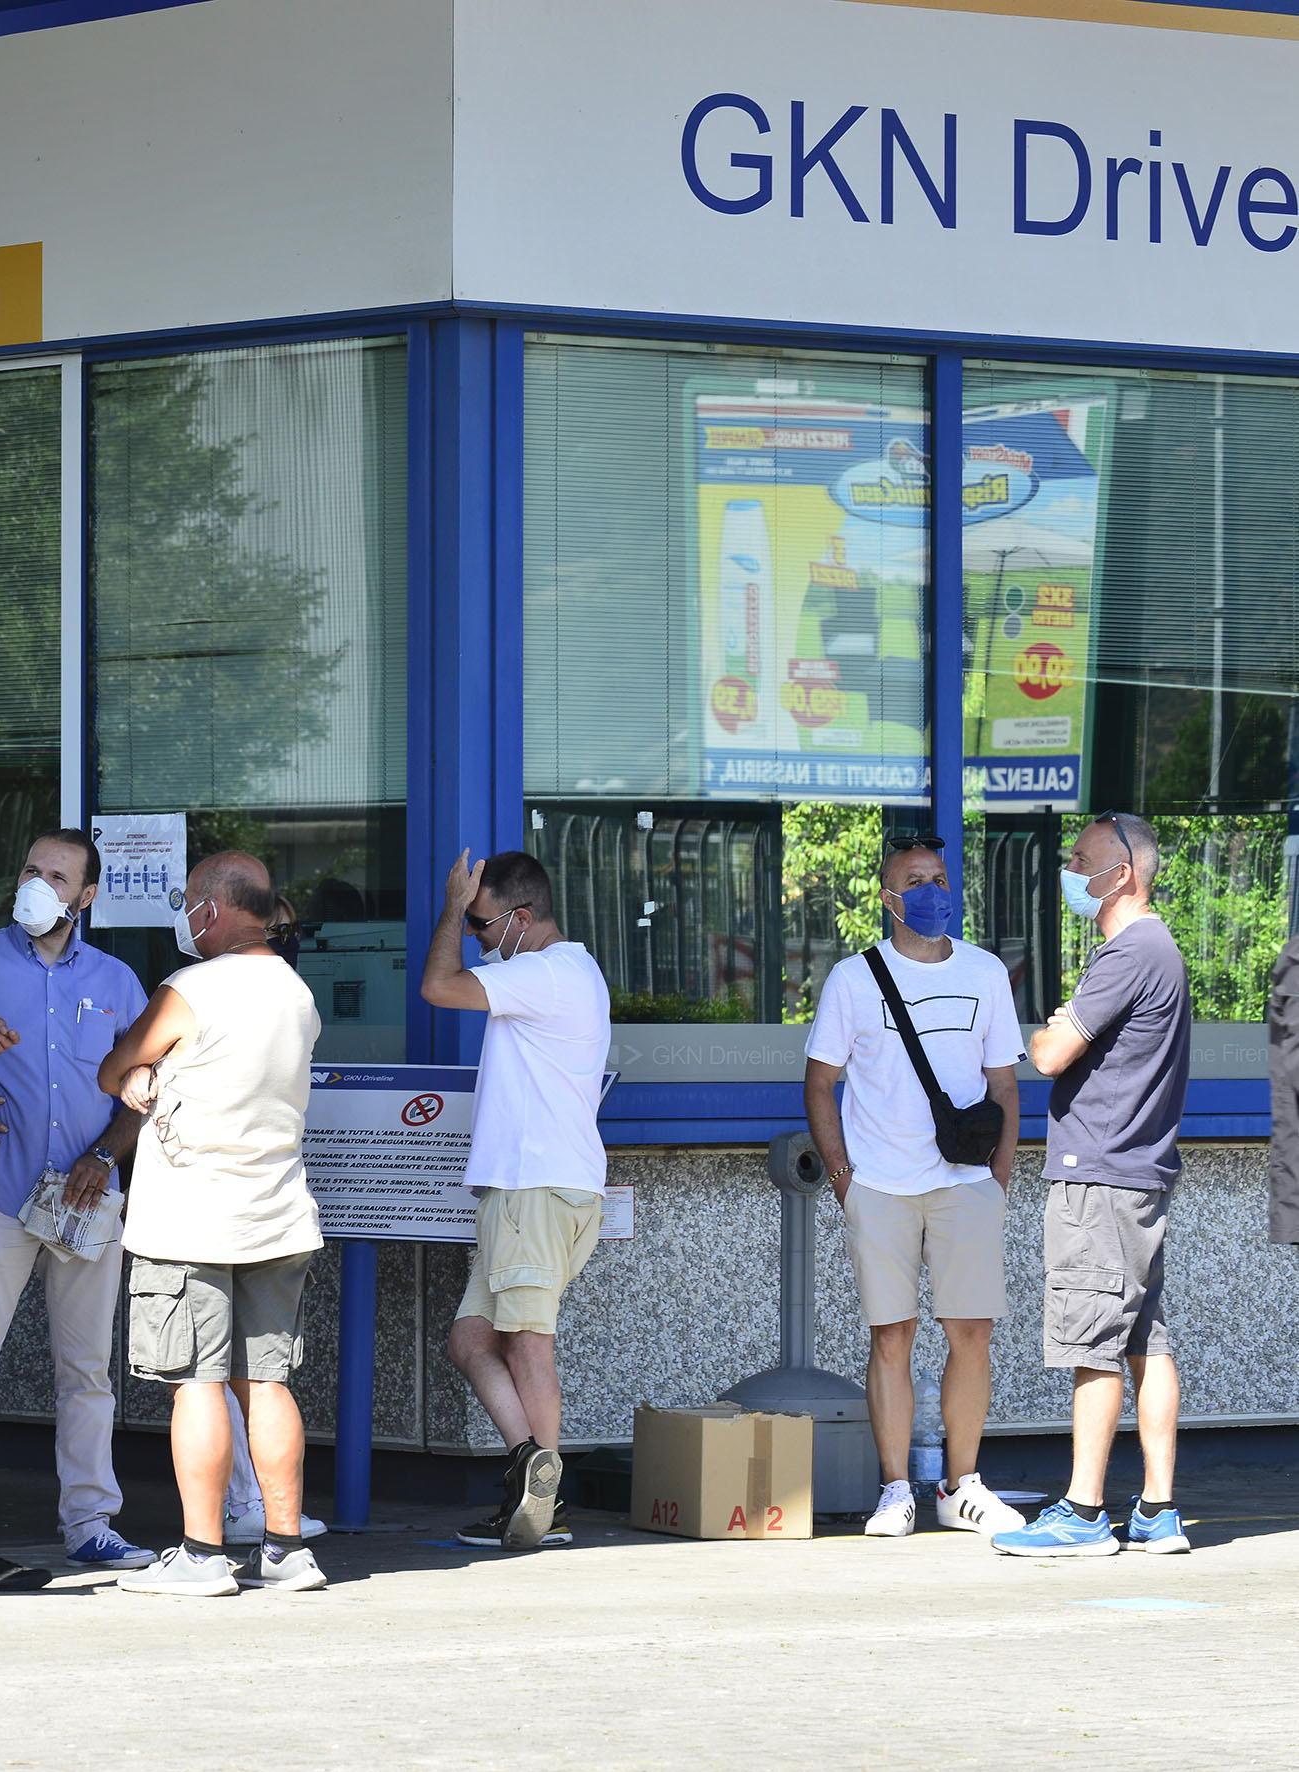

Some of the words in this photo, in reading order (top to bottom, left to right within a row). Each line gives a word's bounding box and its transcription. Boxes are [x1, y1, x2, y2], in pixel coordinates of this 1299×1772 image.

[681, 93, 957, 229] GKN
[1014, 119, 1299, 252] Drive
[652, 1044, 702, 1065] GKN
[709, 1044, 797, 1065] Driveline
[362, 1074, 395, 1082] Driveline
[370, 1138, 442, 1147] ADEGUATAMENTE
[350, 1162, 422, 1170] ADECUADAMENTE
[389, 1179, 431, 1187] SMOKING,
[366, 1187, 412, 1195] IDENTIFIED
[347, 1213, 414, 1221] VORGESEHENEN
[651, 1499, 678, 1527] A12
[727, 1505, 783, 1531] A2
